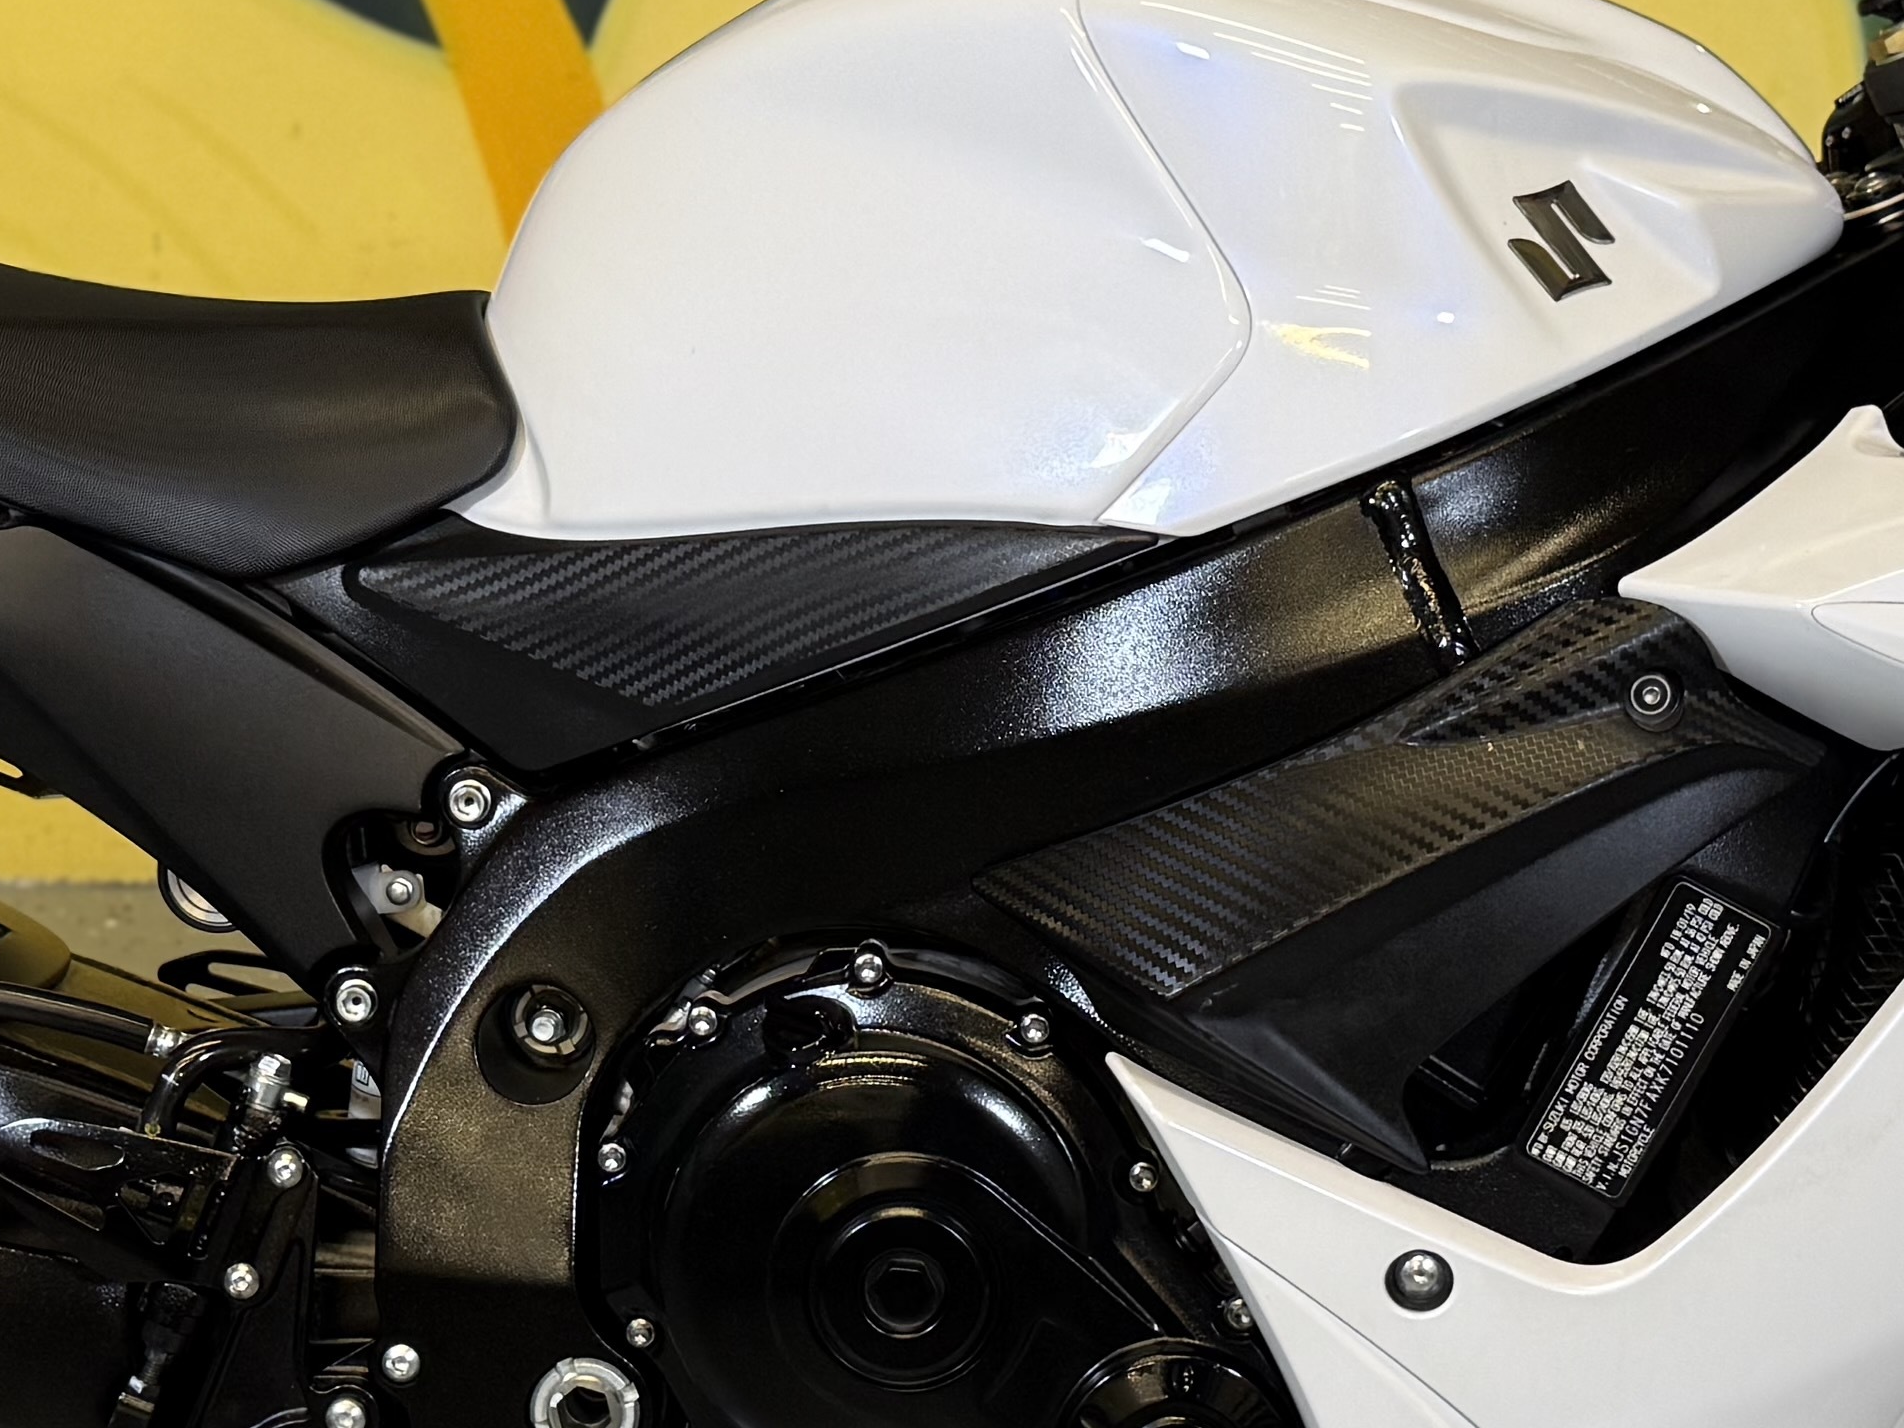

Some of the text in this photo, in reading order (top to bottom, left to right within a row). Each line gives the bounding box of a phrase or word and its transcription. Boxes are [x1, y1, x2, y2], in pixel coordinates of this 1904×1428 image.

[1540, 1095, 1570, 1134] SUZUKI
[1562, 1059, 1591, 1096] MOTOR
[1581, 992, 1629, 1062] CORPORATION
